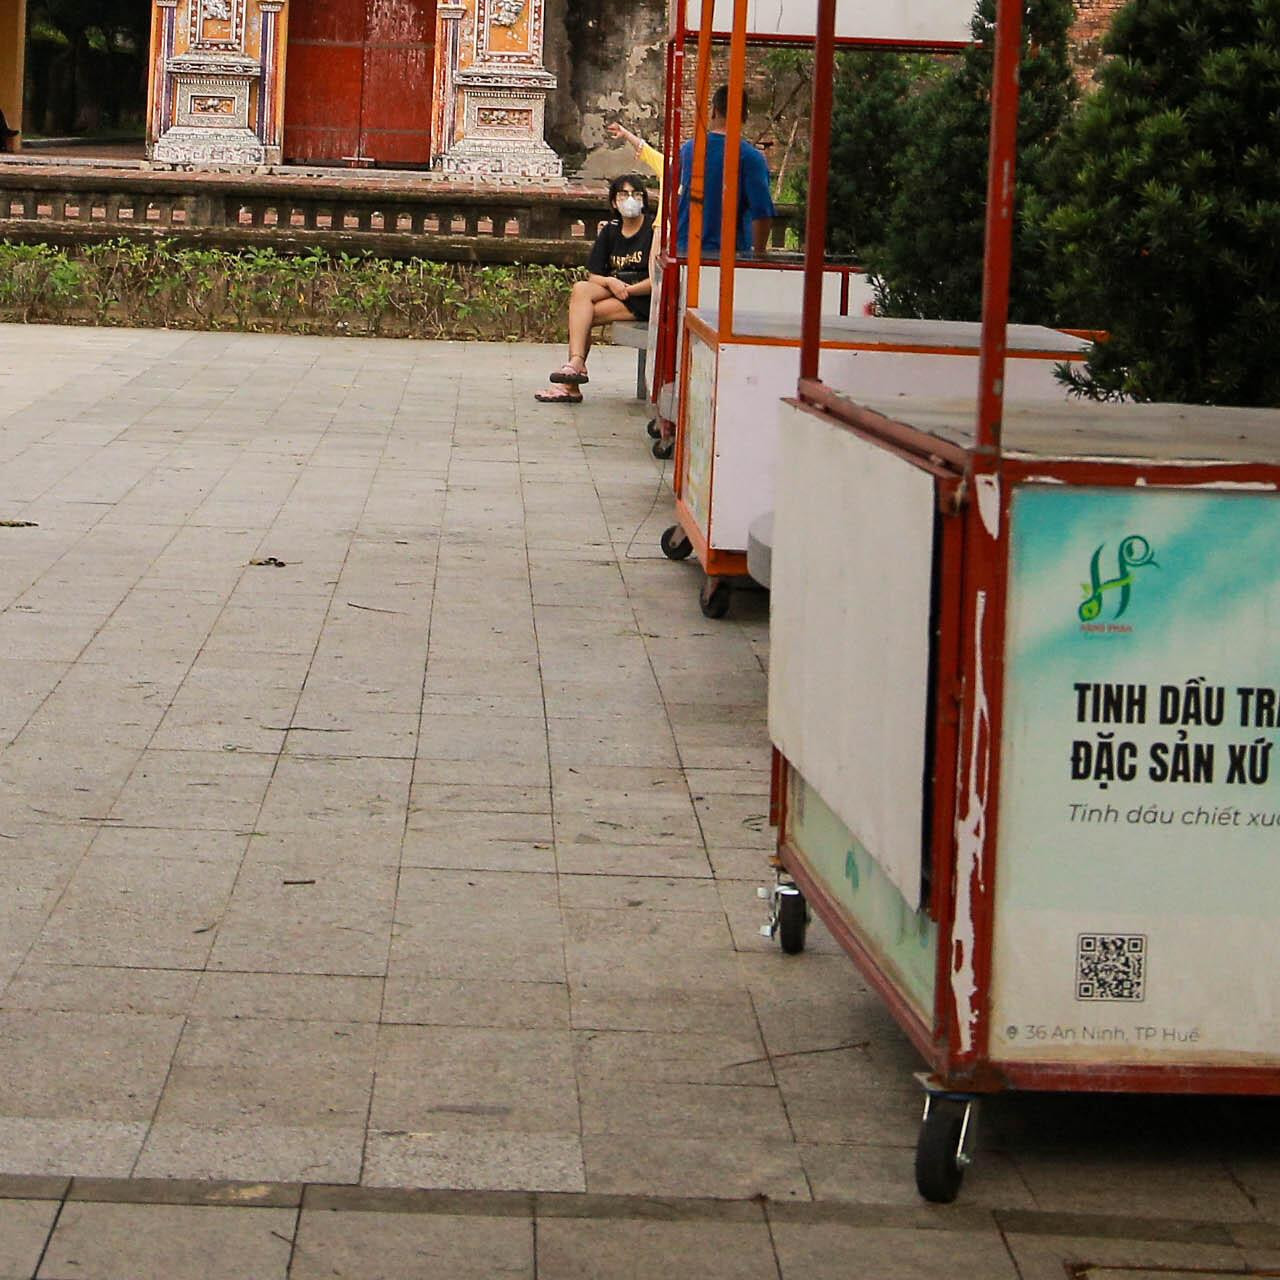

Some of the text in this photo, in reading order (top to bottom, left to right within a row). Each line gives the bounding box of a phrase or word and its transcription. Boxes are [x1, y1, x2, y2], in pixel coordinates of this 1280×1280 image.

[1073, 682, 1147, 724] TINH
[1158, 676, 1225, 727] DẦU
[1070, 731, 1138, 789] ĐẶC
[1148, 729, 1215, 784] SẢN
[1226, 737, 1273, 785] XỨ
[1069, 803, 1119, 824] Tinh
[1181, 806, 1241, 826] chiết
[1024, 1025, 1048, 1041] 36
[1051, 1025, 1077, 1040] An
[1082, 1026, 1129, 1043] Ninh,
[1135, 1026, 1158, 1041] TP
